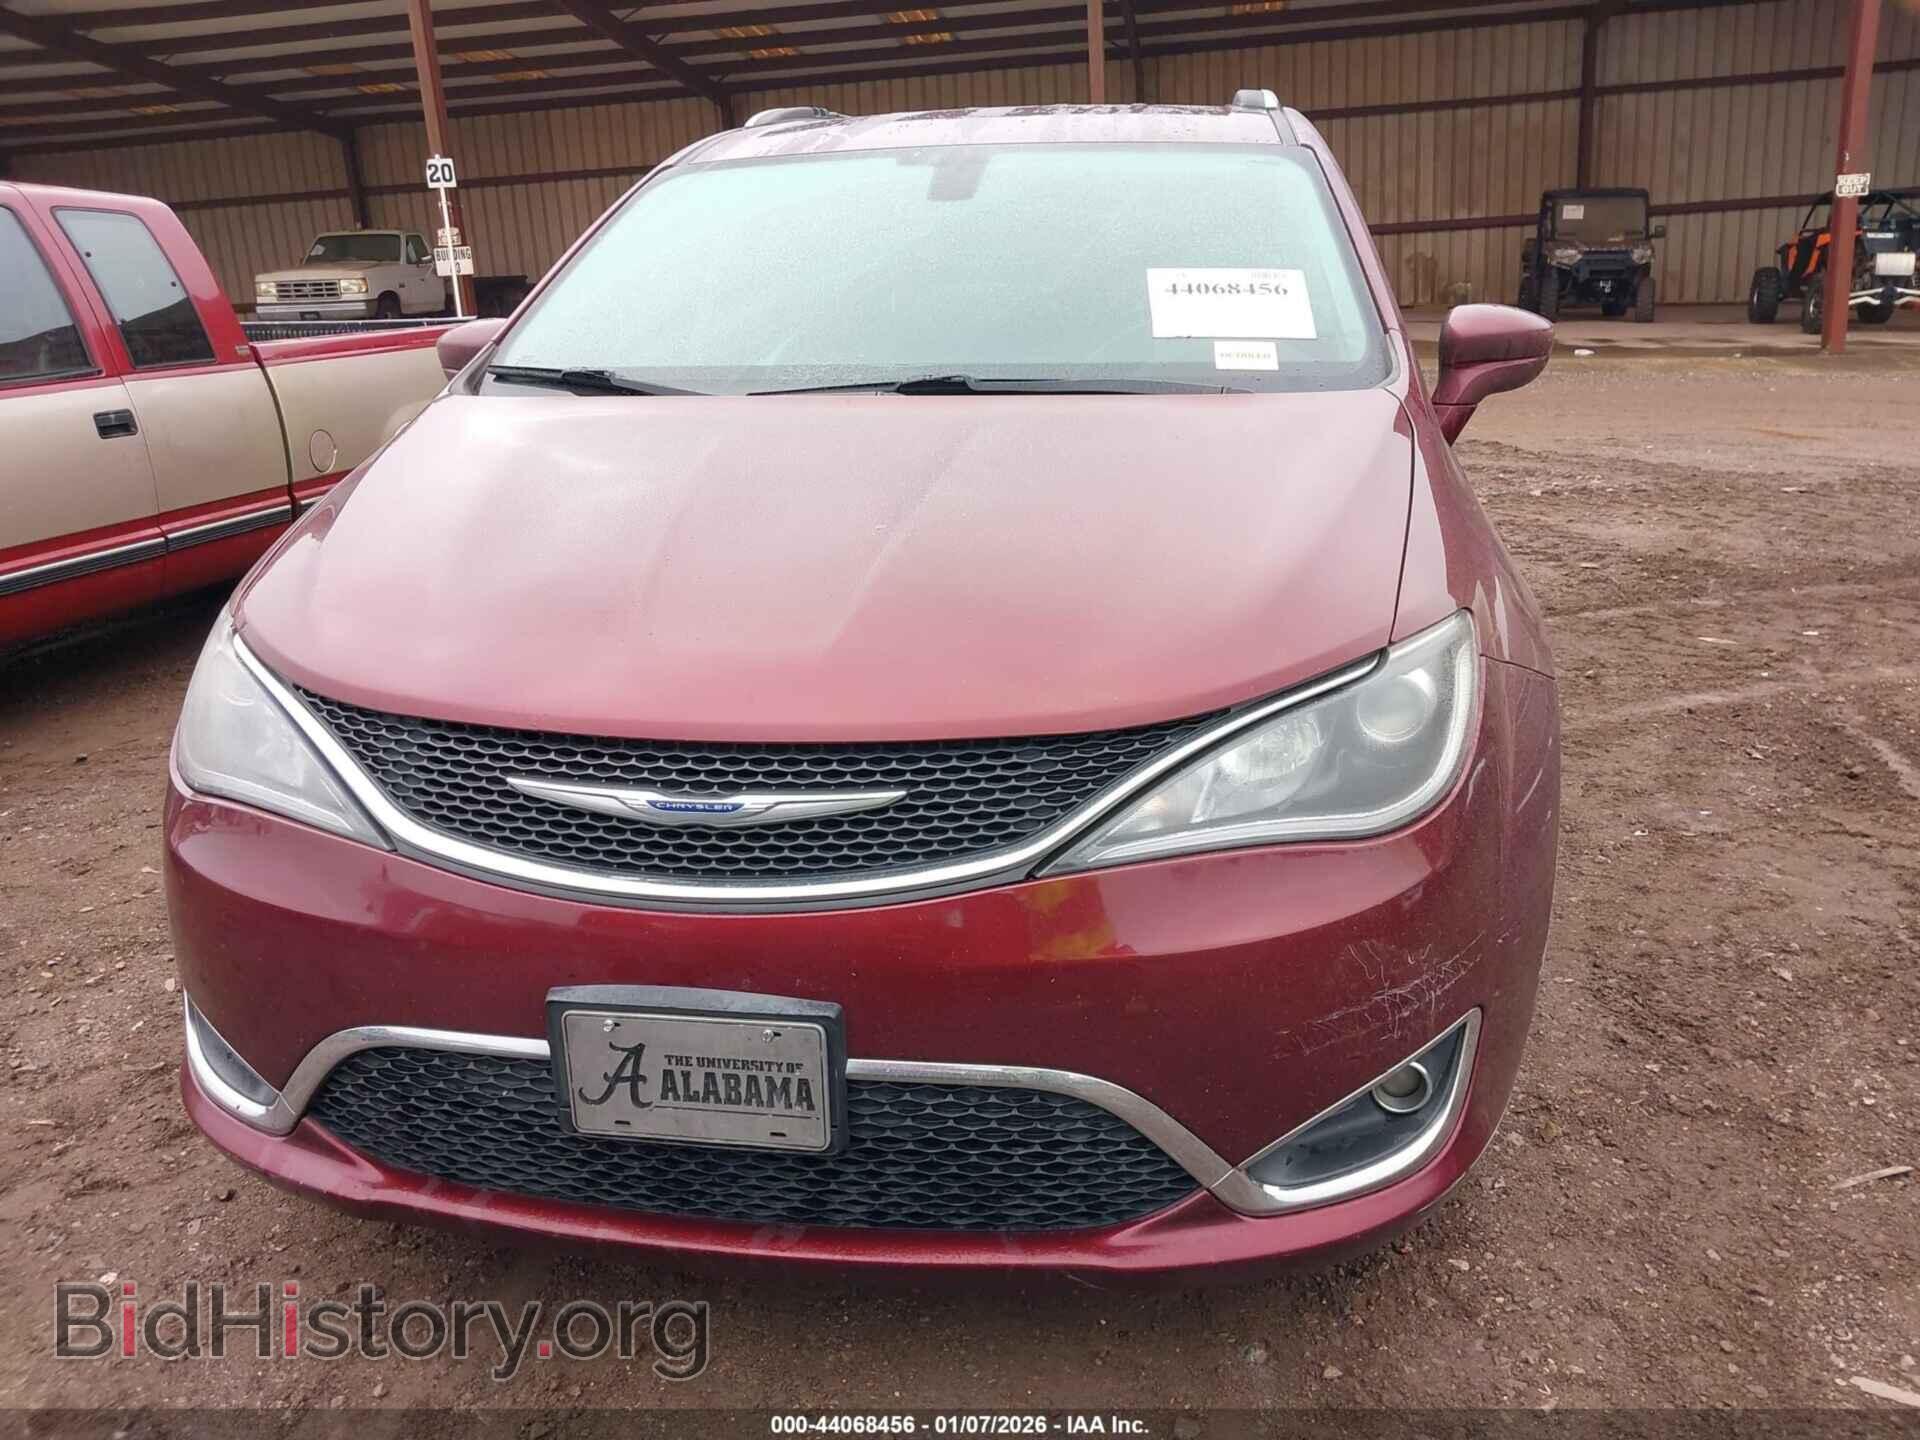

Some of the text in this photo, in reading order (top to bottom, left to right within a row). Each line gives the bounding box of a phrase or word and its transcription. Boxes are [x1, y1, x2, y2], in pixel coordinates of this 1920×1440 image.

[427, 163, 453, 183] 20
[1842, 185, 1864, 194] OUT
[436, 247, 472, 262] BUIDING
[1164, 282, 1289, 296] 44068456
[656, 801, 734, 811] CHRYSLER
[664, 1054, 694, 1068] THE
[696, 1056, 784, 1074] UNIVERSITY
[578, 1041, 655, 1109] A
[660, 1068, 817, 1112] ALABAMA
